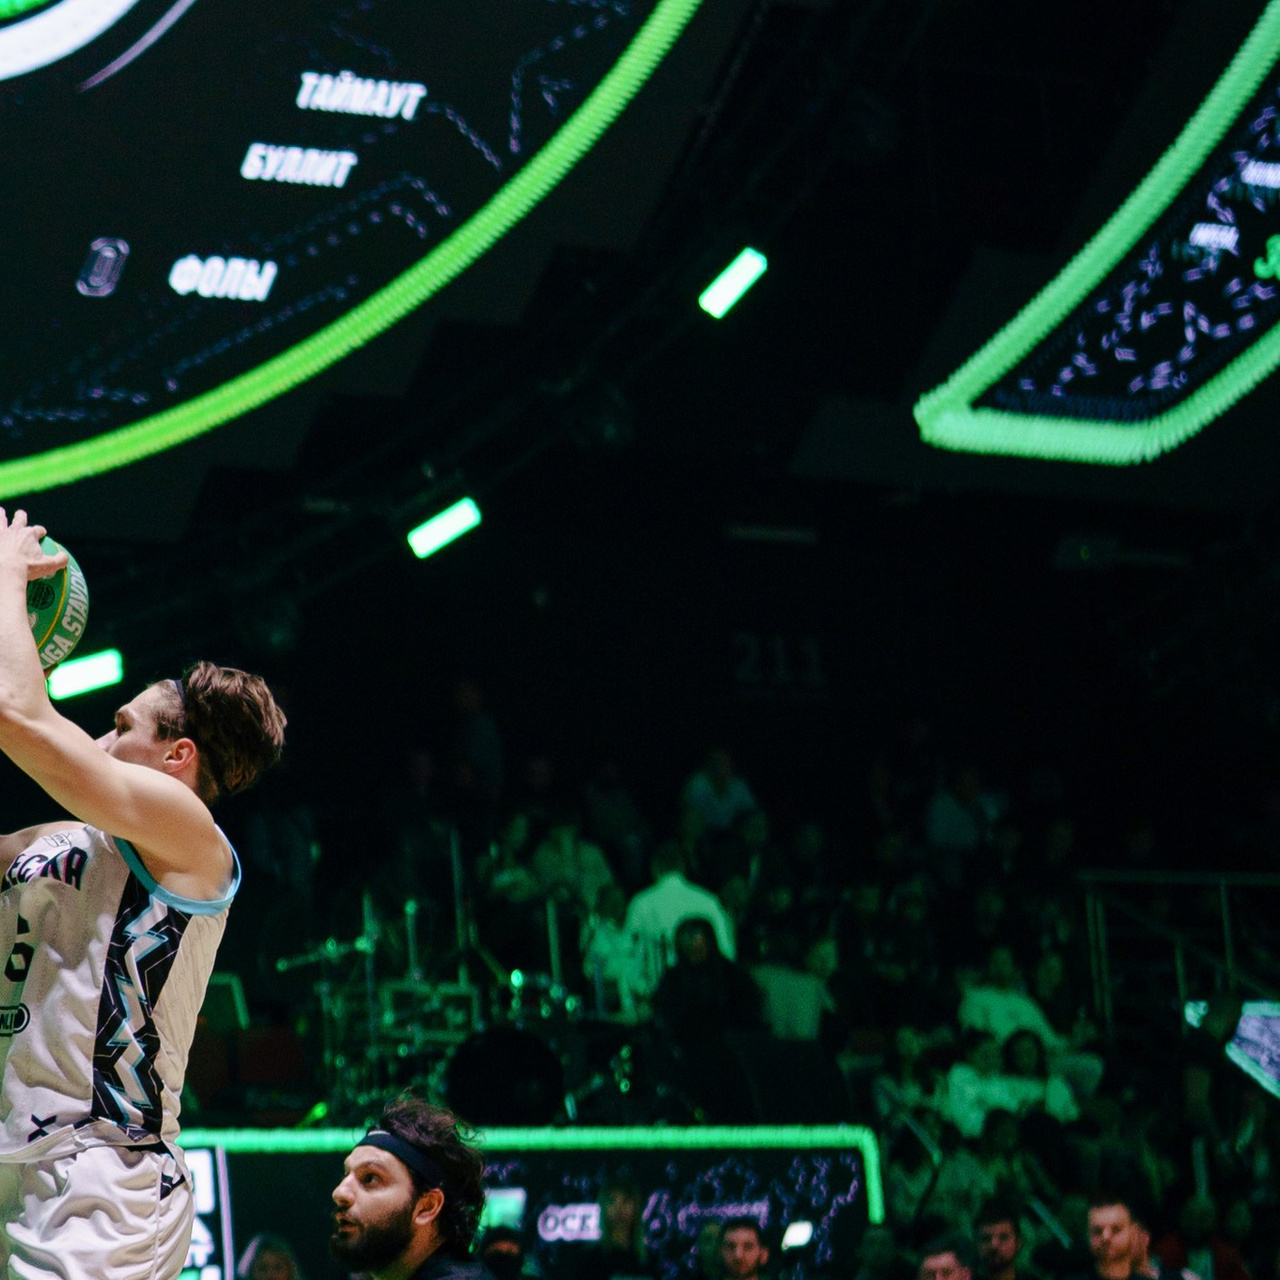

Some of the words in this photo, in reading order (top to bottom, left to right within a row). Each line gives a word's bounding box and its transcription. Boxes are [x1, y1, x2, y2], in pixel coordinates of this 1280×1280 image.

[296, 70, 427, 120] ТАЙМАУТ
[240, 142, 358, 188] БУЛЛИТ
[168, 253, 278, 302] ФОЛЫ
